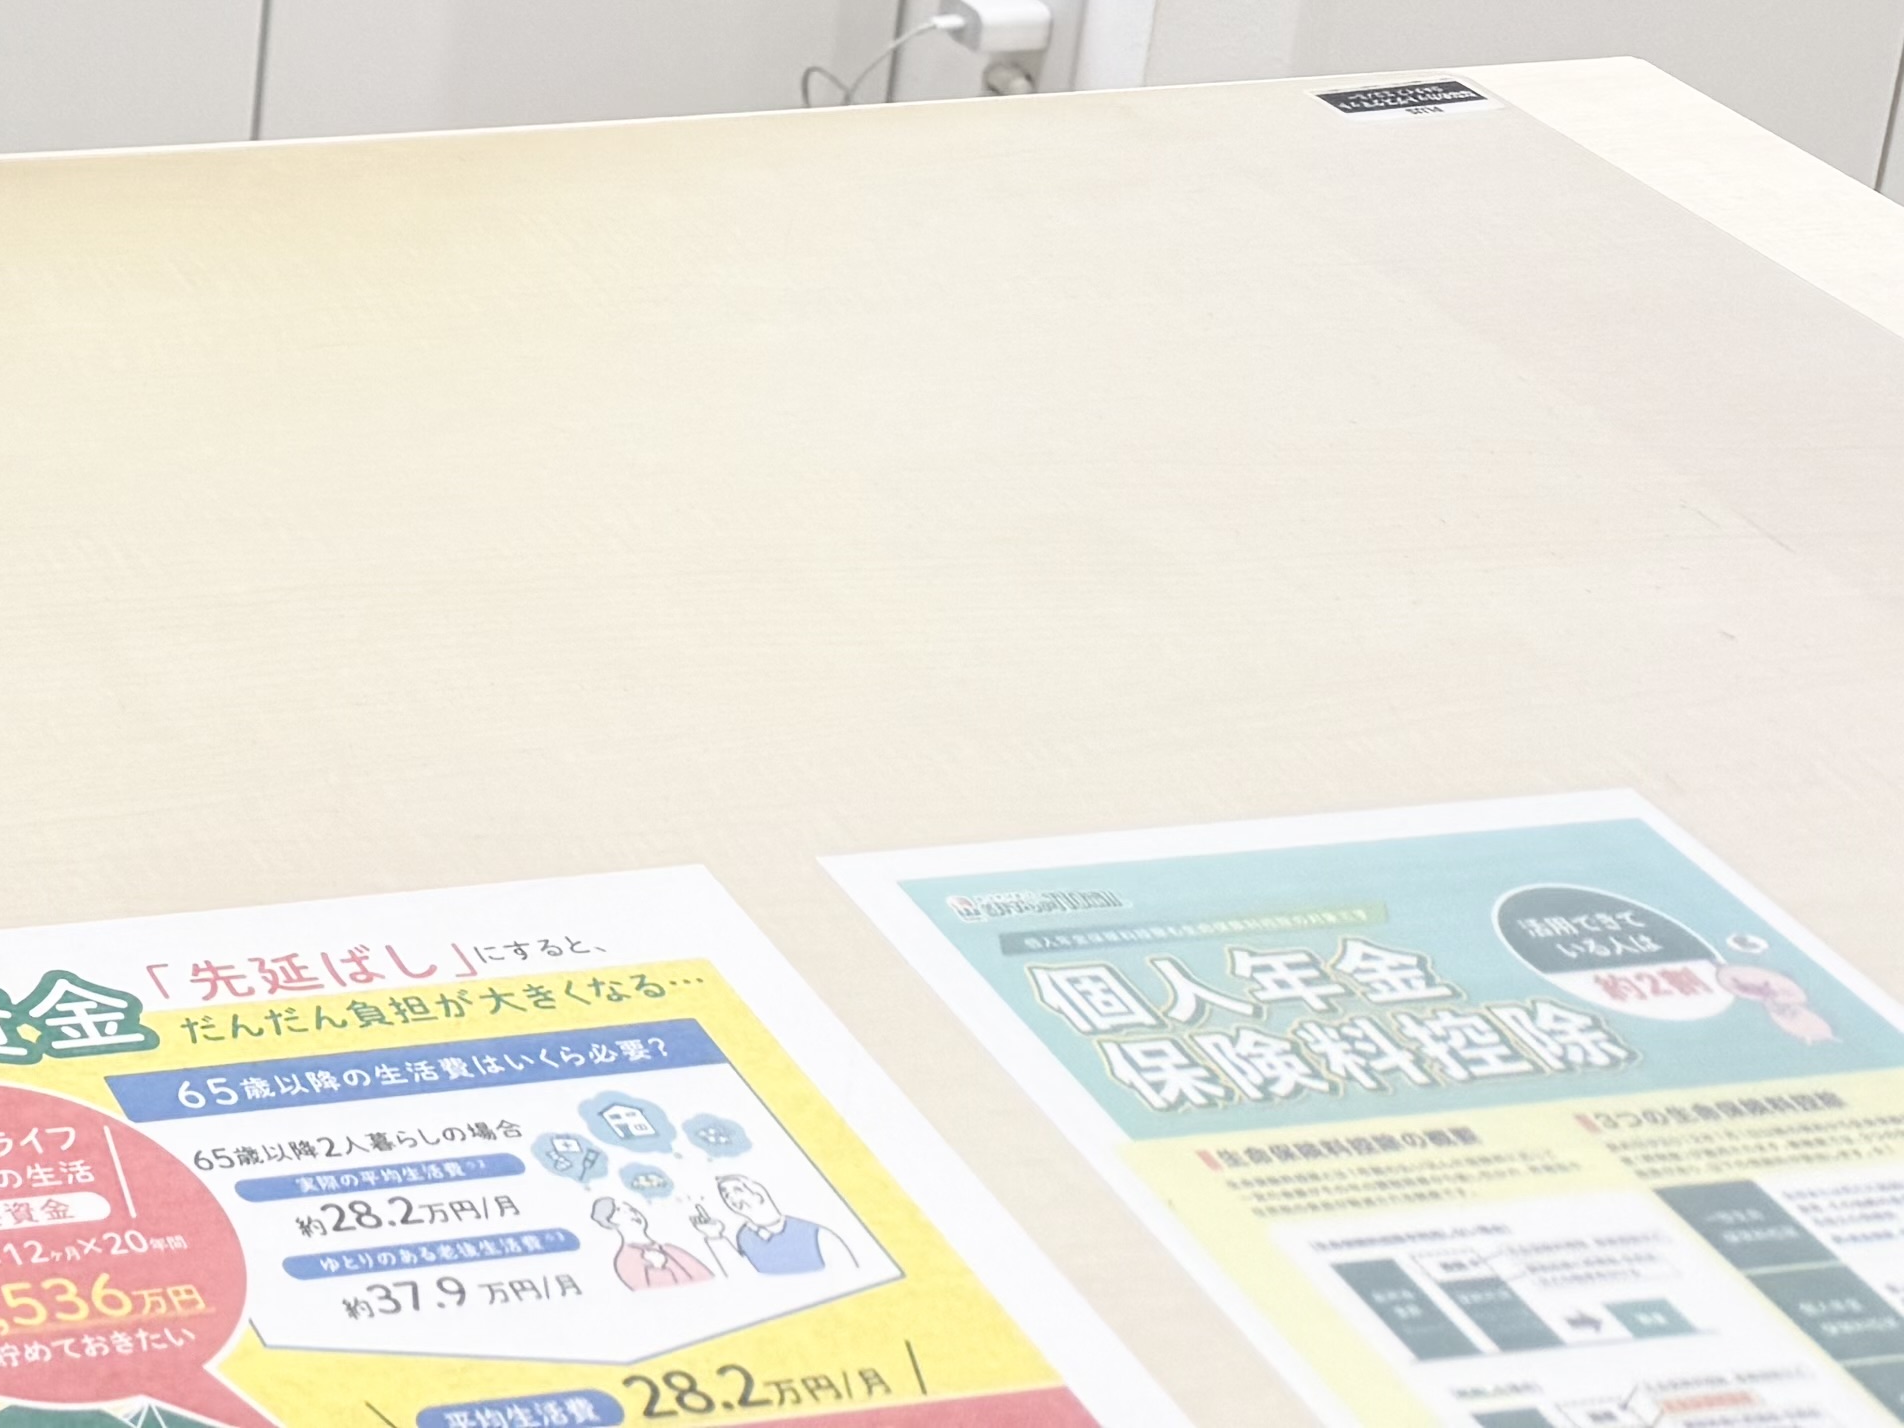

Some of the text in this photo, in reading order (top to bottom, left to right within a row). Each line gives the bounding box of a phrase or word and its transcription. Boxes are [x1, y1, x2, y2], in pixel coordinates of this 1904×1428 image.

[1028, 938, 1464, 1034] 個人年金
[1097, 1001, 1632, 1111] 保険料控除
[192, 1119, 524, 1172] 65歳以降2人暮らしの場合
